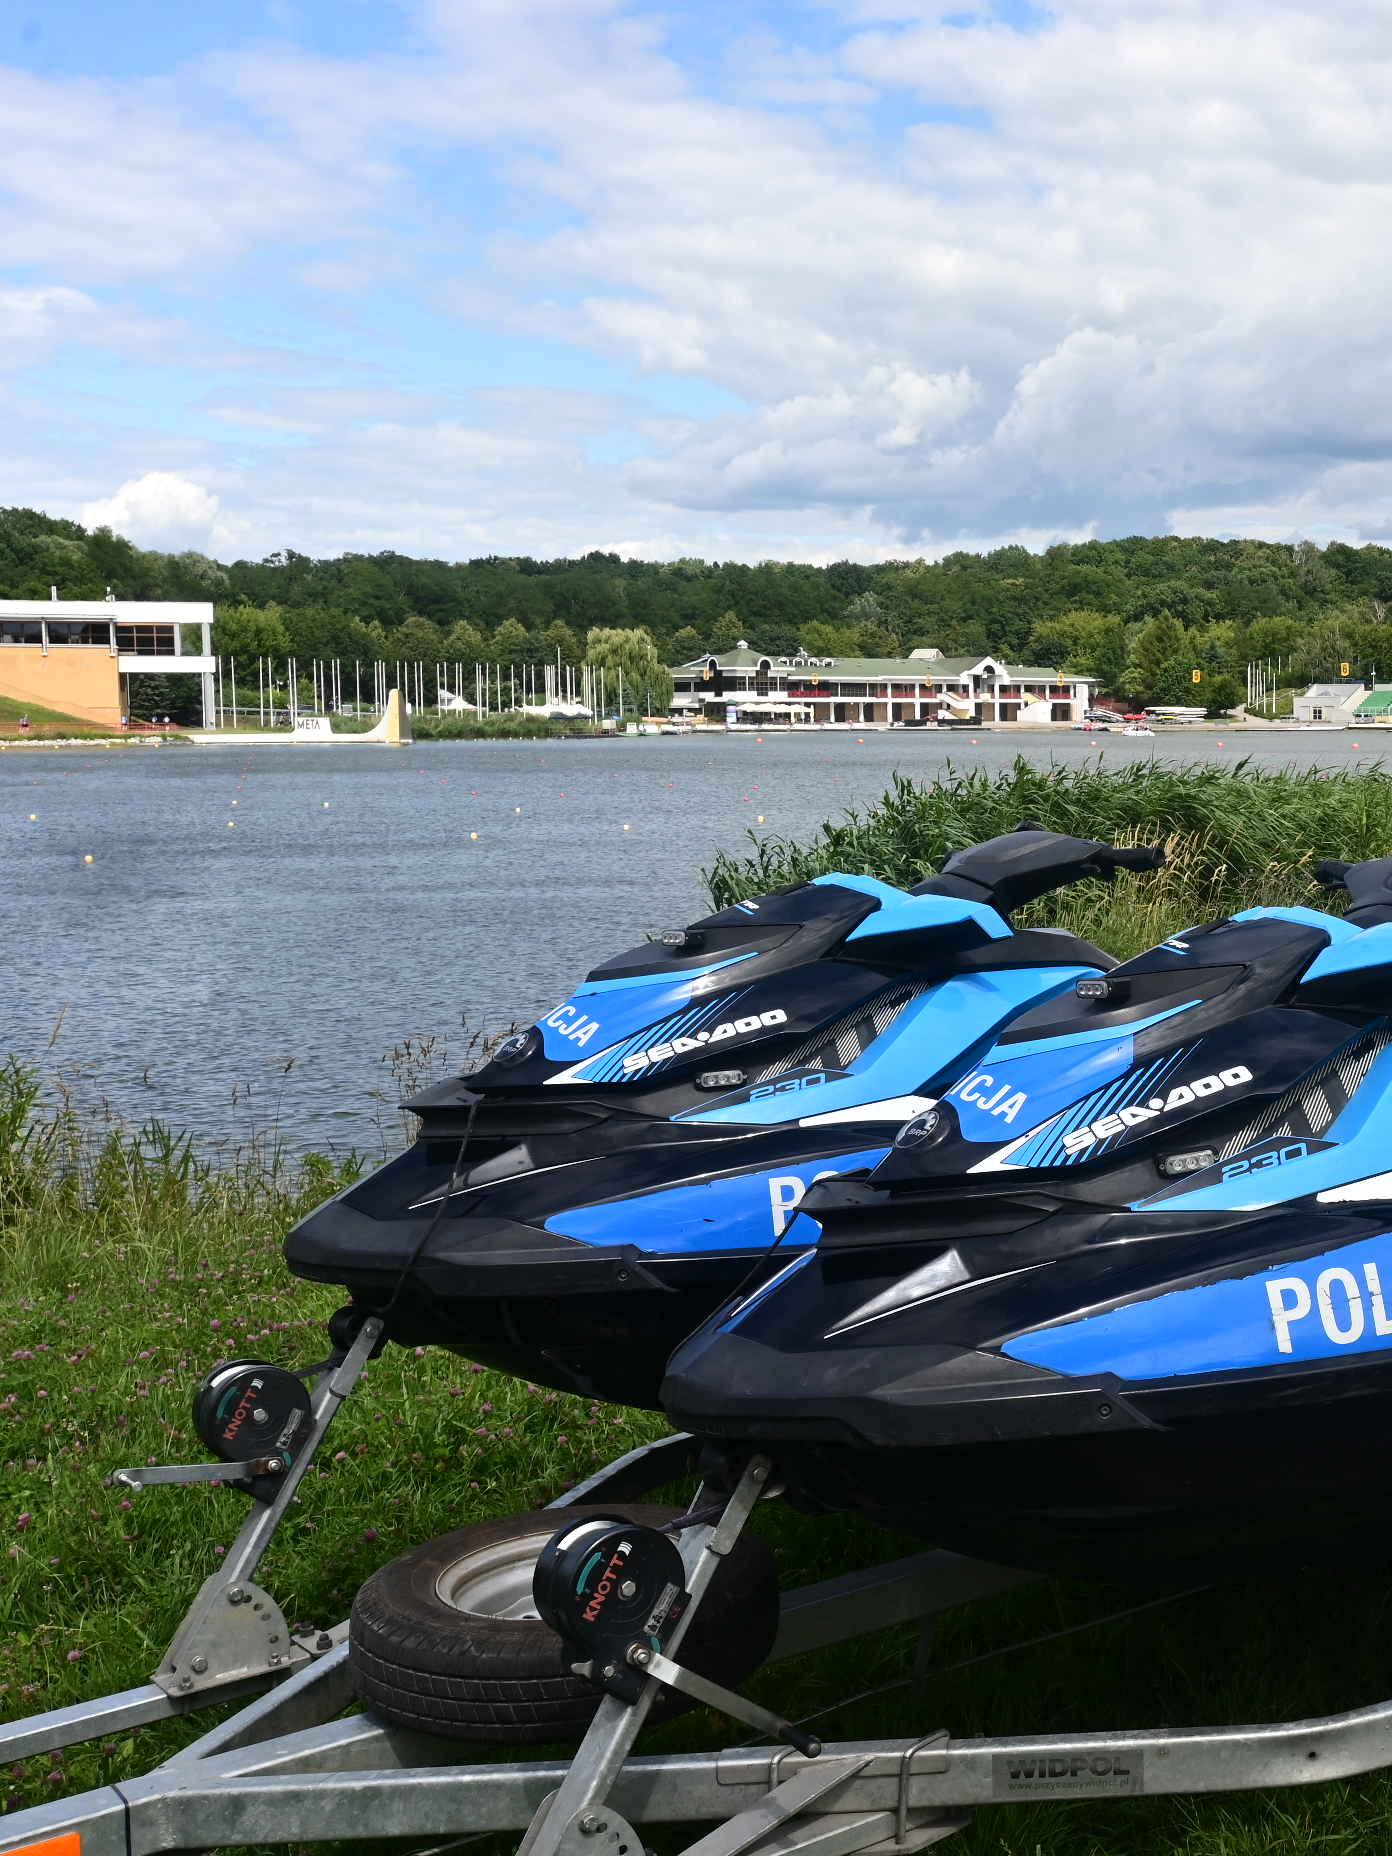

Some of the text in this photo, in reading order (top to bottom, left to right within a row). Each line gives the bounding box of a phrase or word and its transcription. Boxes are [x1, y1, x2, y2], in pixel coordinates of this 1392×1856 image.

[297, 719, 320, 730] META
[750, 1073, 826, 1101] 230
[1222, 1143, 1308, 1184] 230
[223, 1387, 257, 1440] KNOTT
[582, 1553, 624, 1622] KNOTT
[1005, 1756, 1130, 1779] WIDPOL
